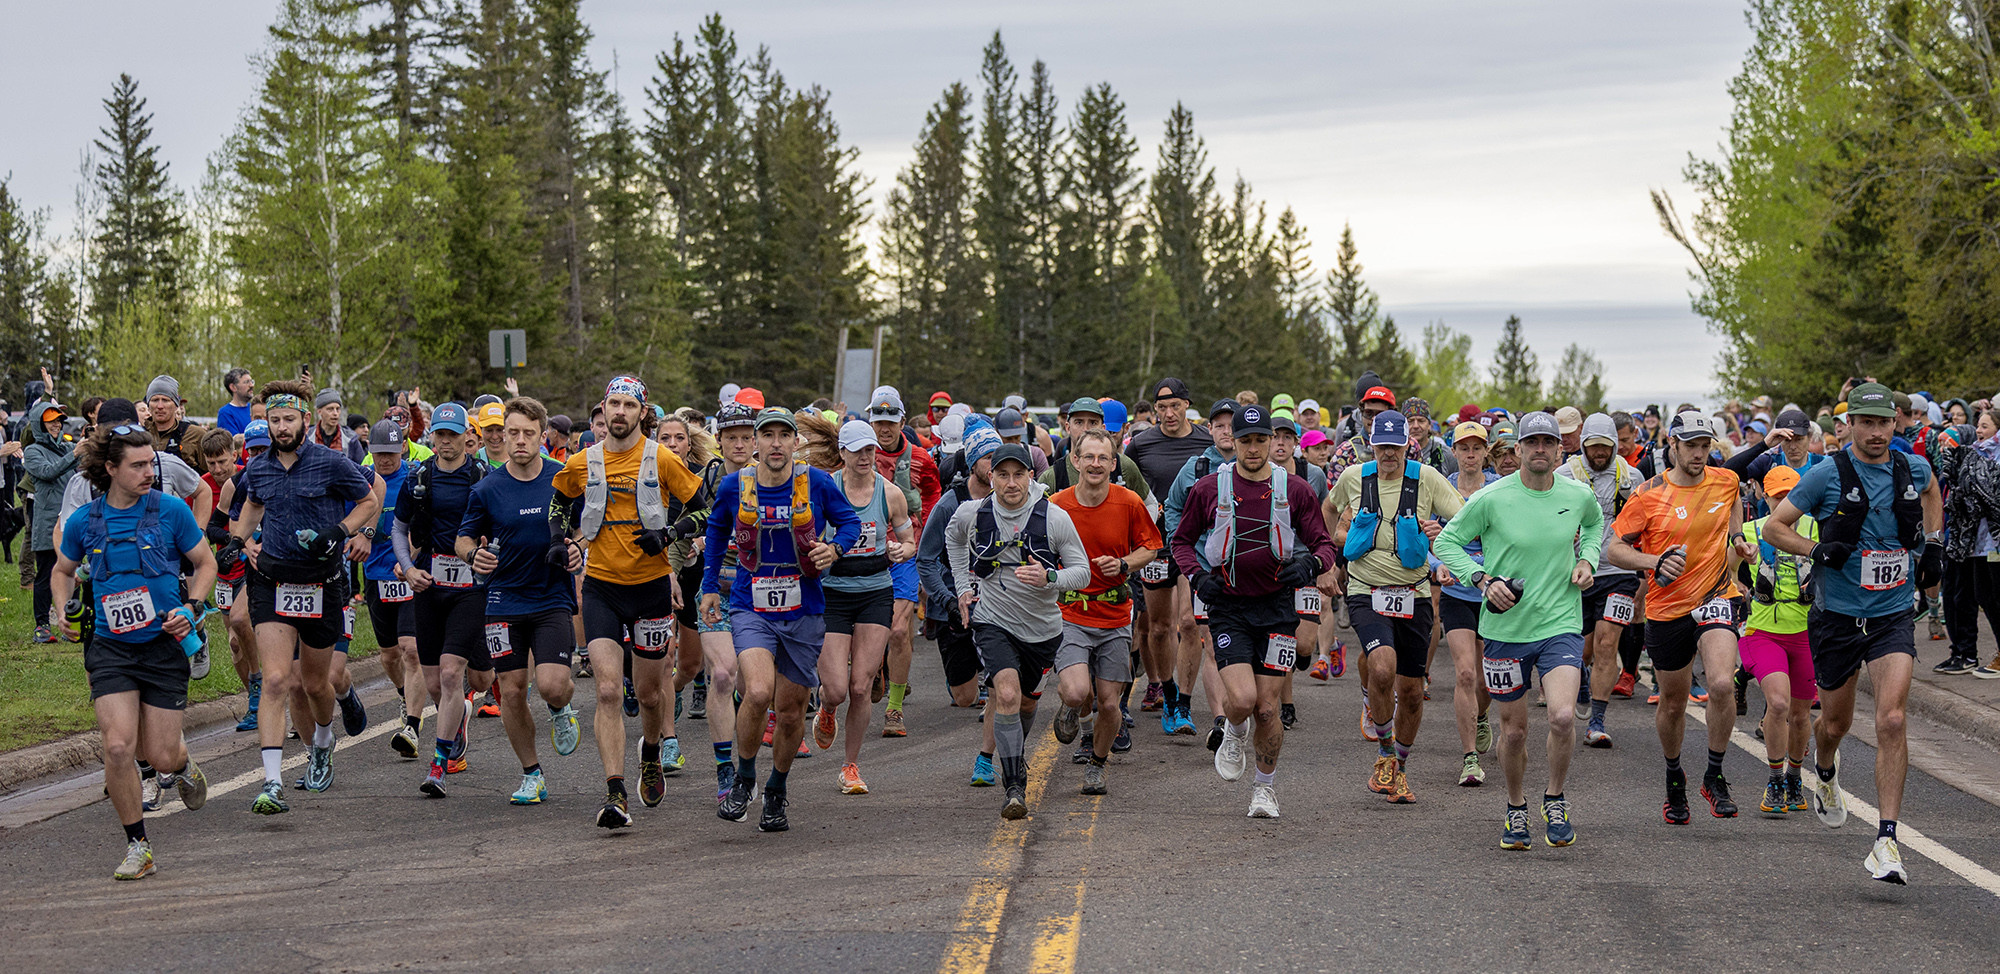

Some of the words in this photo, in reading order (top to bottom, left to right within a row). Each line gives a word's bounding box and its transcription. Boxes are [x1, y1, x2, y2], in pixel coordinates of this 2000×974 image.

[520, 507, 541, 515] BANDIT
[445, 567, 459, 582] 17
[1872, 564, 1902, 584] 182
[384, 583, 407, 597] 280
[283, 595, 314, 612] 233
[767, 590, 787, 607] 67
[1302, 597, 1320, 610] 178
[1385, 596, 1403, 612] 26
[111, 603, 147, 628] 298
[1612, 604, 1631, 620] 199
[1699, 605, 1730, 621] 294
[1278, 648, 1294, 667] 65
[1486, 671, 1513, 688] 144
